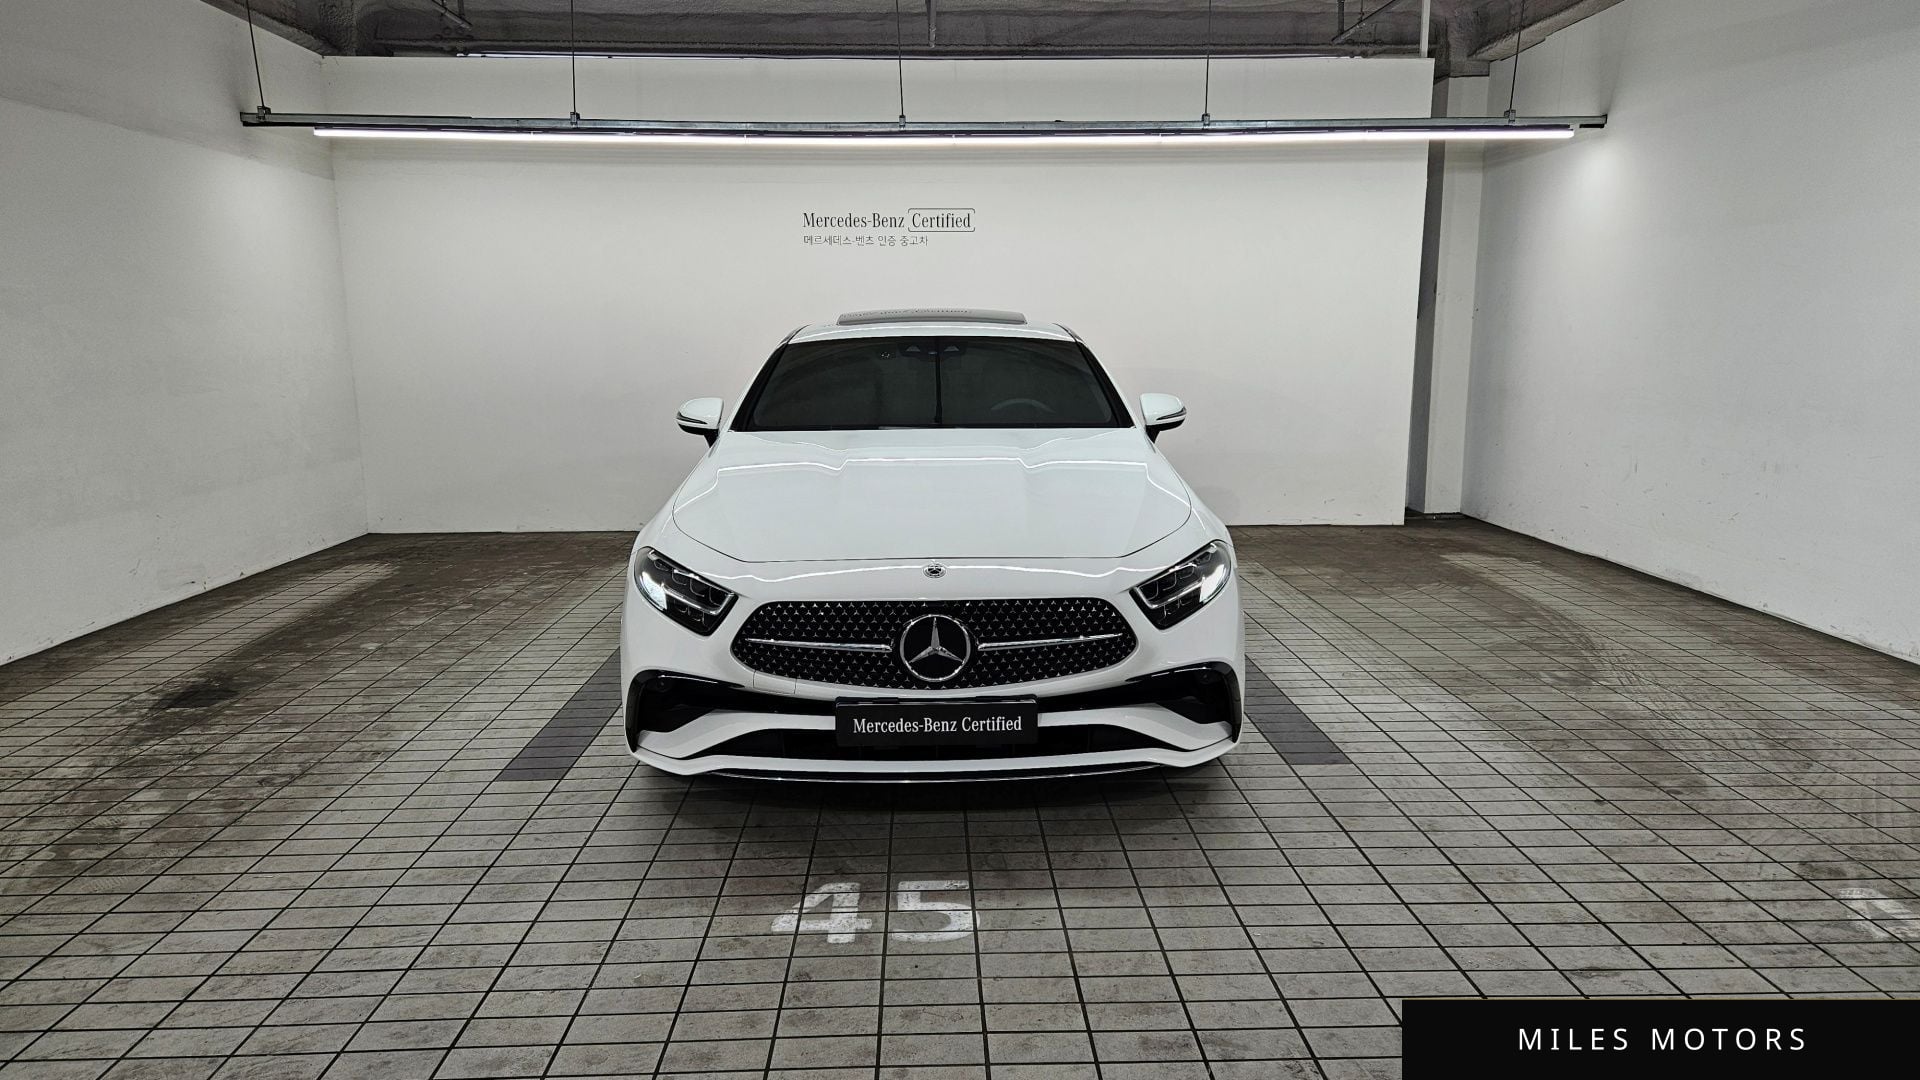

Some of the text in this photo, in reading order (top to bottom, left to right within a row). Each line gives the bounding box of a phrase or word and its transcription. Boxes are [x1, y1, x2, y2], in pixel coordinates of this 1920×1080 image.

[802, 212, 971, 228] Mercedes-Benz Certified
[803, 234, 929, 247] 메르세데스-벤츠 인증 중고차
[853, 715, 1023, 733] Mercedes-Benz Certified
[770, 879, 981, 944] 45
